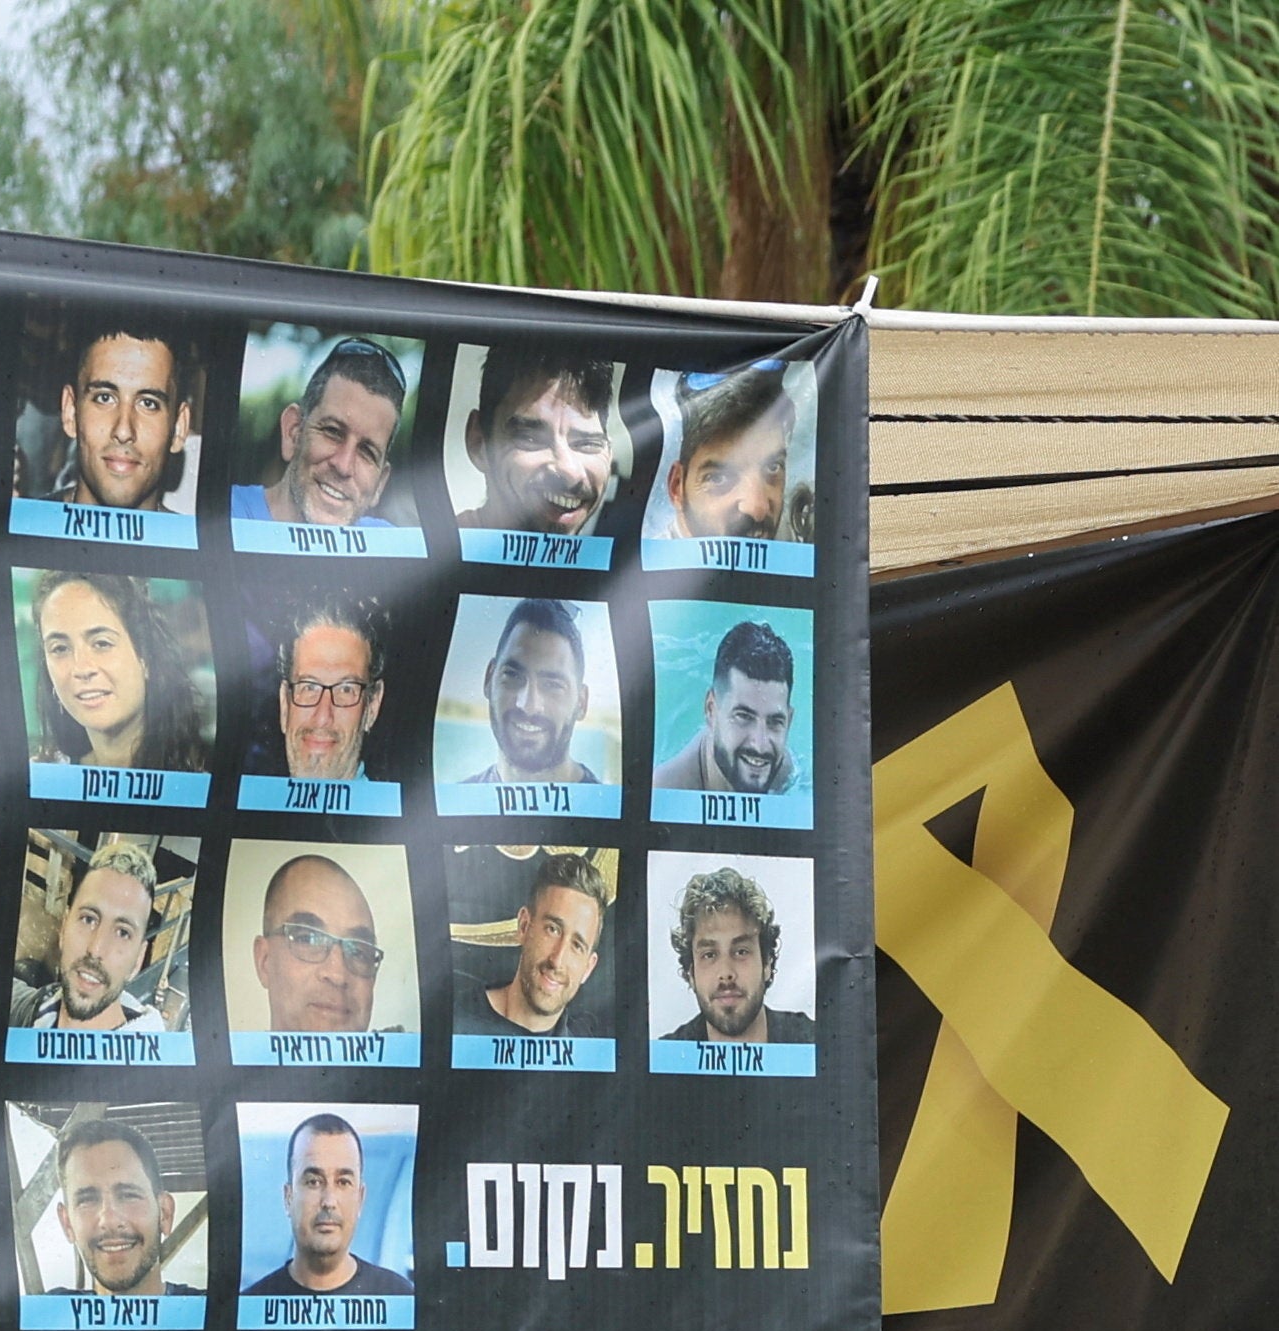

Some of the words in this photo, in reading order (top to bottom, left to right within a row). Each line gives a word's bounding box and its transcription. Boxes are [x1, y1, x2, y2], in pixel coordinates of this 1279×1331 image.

[63, 504, 111, 539] דניאל
[116, 512, 144, 541] עוז
[288, 527, 337, 553] חיימי
[339, 526, 367, 553] טל
[502, 533, 540, 565] קוניו
[540, 534, 583, 565] אריאל
[699, 540, 741, 569] קוניו
[745, 541, 768, 570] דוד
[82, 768, 120, 800] הימן
[125, 771, 165, 801] ענבר
[285, 779, 321, 810] אנגל
[322, 783, 351, 812] רונן
[543, 783, 572, 812] גלי
[495, 785, 539, 816] ברמן
[700, 794, 737, 824] ברמן
[741, 796, 761, 823] זיו
[38, 1032, 96, 1060] בוחבוט
[102, 1032, 161, 1064] אלקנה
[270, 1035, 333, 1065] רודאיף
[336, 1035, 385, 1063] ליאור
[492, 1038, 516, 1065] אור
[520, 1038, 574, 1069] אבינתן
[696, 1043, 727, 1071] אהל
[731, 1045, 764, 1075] אלון
[445, 1162, 623, 1281] נקום.
[634, 1164, 809, 1270] נחזיר.
[70, 1298, 106, 1330] פרץ
[110, 1297, 160, 1326] דניאל
[264, 1297, 336, 1325] אלאטרש
[340, 1298, 387, 1325] מחמד
